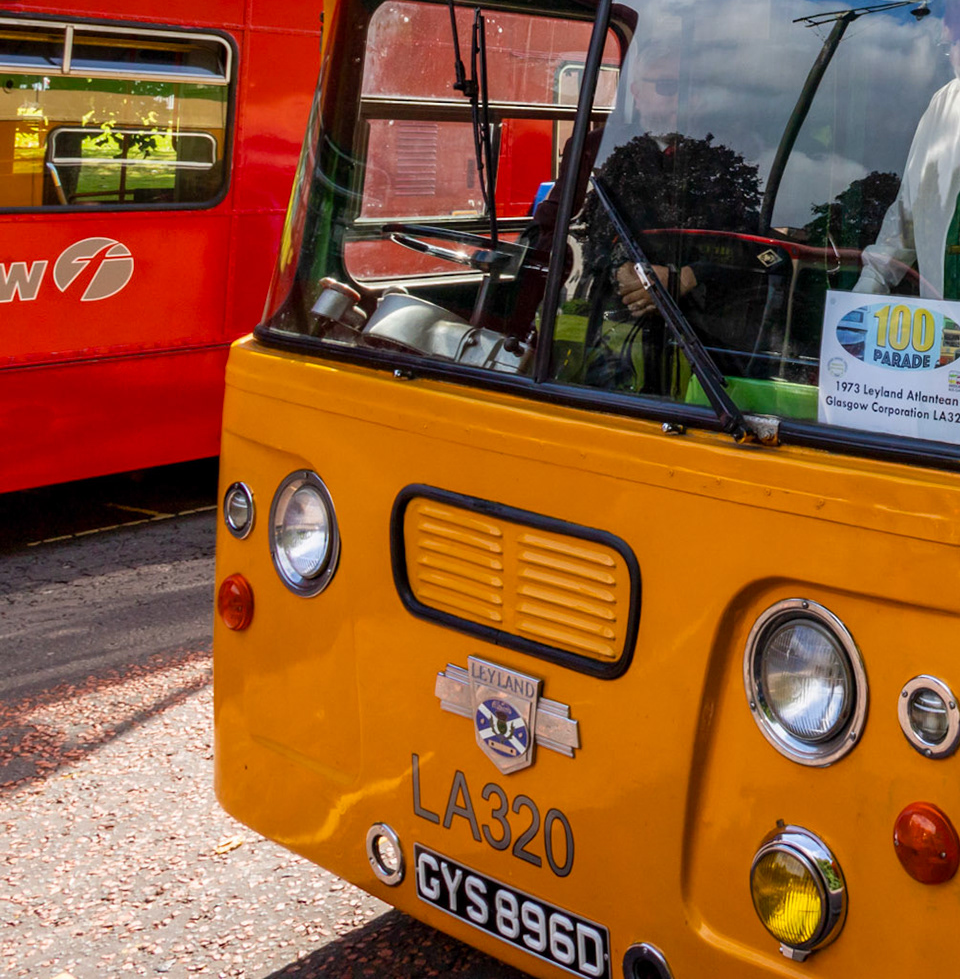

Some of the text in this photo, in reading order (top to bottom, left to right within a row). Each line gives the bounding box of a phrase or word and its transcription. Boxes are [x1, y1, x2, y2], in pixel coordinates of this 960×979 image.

[873, 304, 935, 352] 100
[873, 349, 931, 369] PARADE
[825, 395, 869, 411] Glasgow
[871, 401, 930, 420] Corporation
[836, 381, 959, 406] 1973 Leyland Atlantean
[471, 662, 535, 699] LEYLAND
[411, 753, 574, 877] LA320
